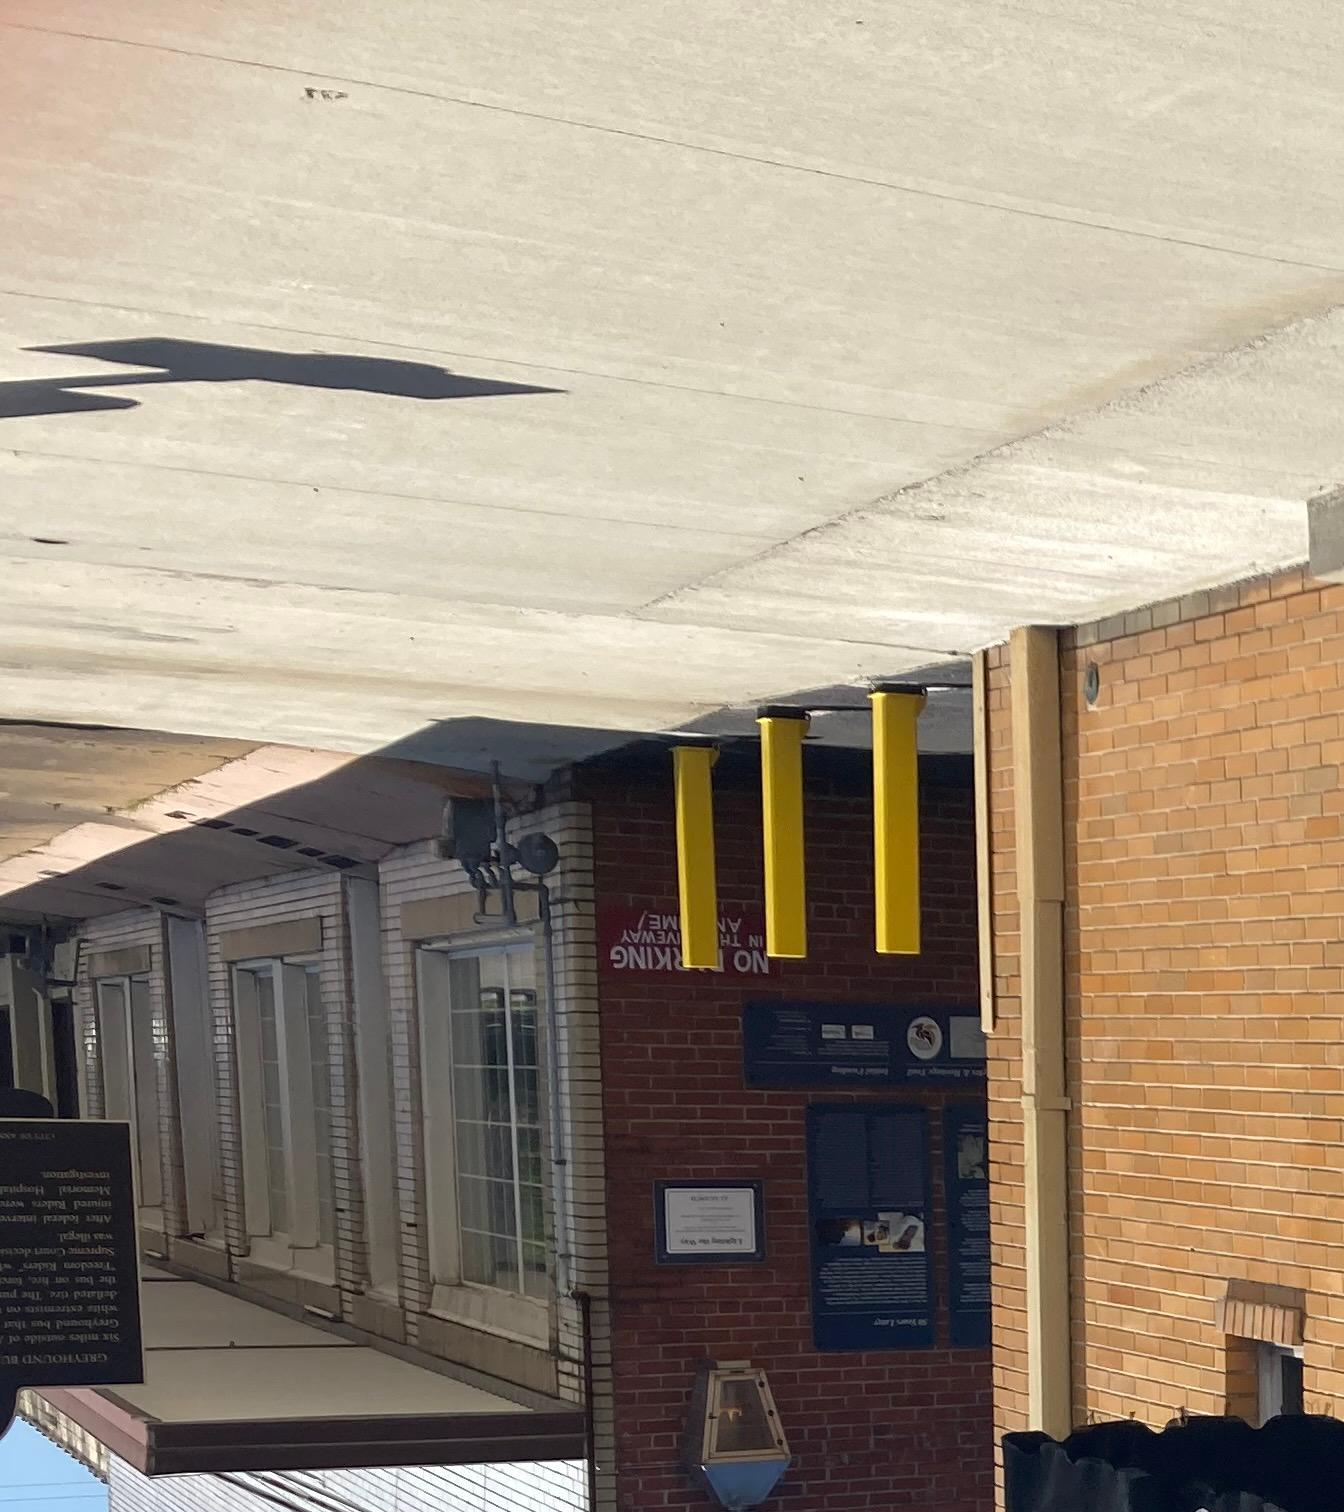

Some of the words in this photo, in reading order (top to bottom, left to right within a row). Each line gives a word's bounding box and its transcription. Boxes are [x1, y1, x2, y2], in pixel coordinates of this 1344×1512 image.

[720, 933, 741, 947] TH
[748, 934, 762, 947] IN
[610, 945, 725, 973] PRKING
[733, 950, 769, 973] NO
[57, 1185, 111, 1195] Memorial
[31, 1200, 66, 1209] Riders
[73, 1200, 112, 1210] injured
[42, 1214, 79, 1224] federal
[86, 1214, 112, 1223] After
[93, 1232, 114, 1240] was
[33, 1246, 66, 1257] Court
[68, 1244, 115, 1257] Supreme
[75, 1276, 94, 1286] bus
[99, 1275, 116, 1285] the
[21, 1291, 41, 1301] The
[73, 1290, 118, 1300] deflated
[25, 1304, 83, 1313] extremists
[87, 1304, 118, 1313] white
[3, 1321, 26, 1331] that
[30, 1320, 51, 1330] bus
[56, 1318, 119, 1329] Greyhound
[8, 1335, 21, 1344] of
[24, 1334, 65, 1344] outside
[69, 1333, 99, 1344] miles
[102, 1333, 119, 1343] Six
[22, 1353, 107, 1364] GREYHOUND
